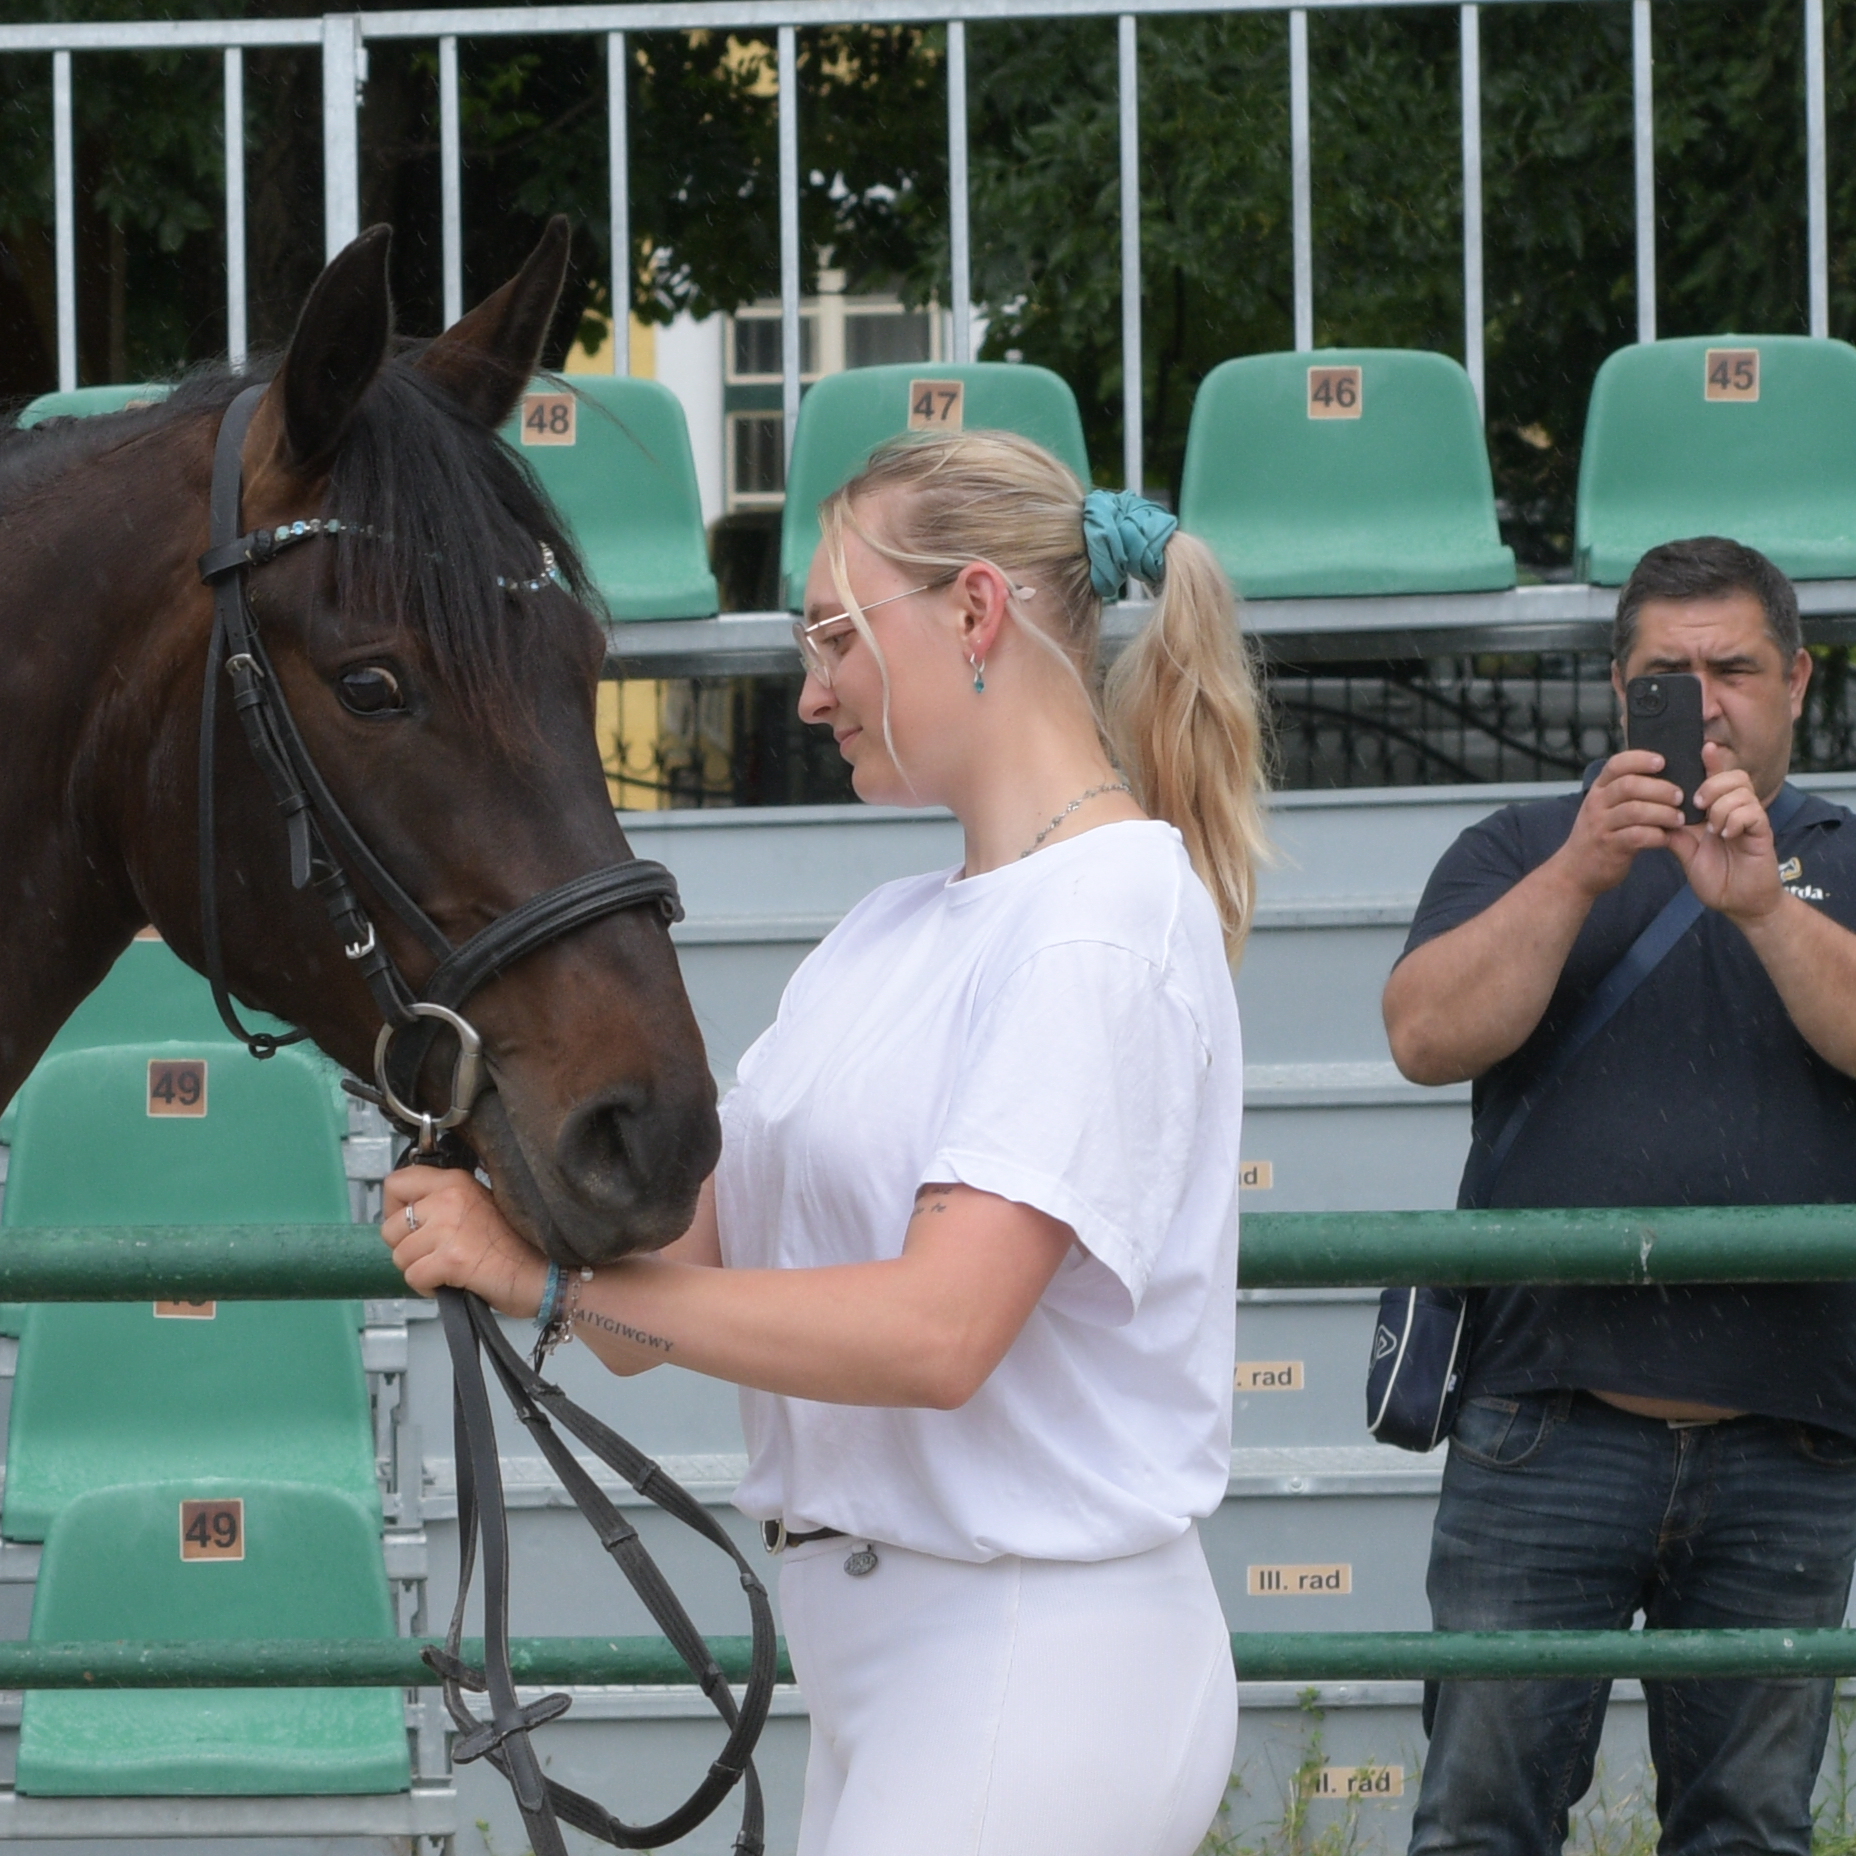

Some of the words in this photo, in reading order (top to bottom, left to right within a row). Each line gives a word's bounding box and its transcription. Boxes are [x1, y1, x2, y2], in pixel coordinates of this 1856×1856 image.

[1708, 360, 1754, 391] 45
[913, 391, 957, 421] 47
[1312, 377, 1356, 409] 46
[526, 404, 570, 436] 48
[152, 1070, 200, 1106] 49
[1252, 1366, 1292, 1386] rad
[185, 1512, 237, 1549] 49
[1259, 1570, 1288, 1590] III.
[1298, 1569, 1341, 1590] rad
[1347, 1771, 1390, 1793] rad
